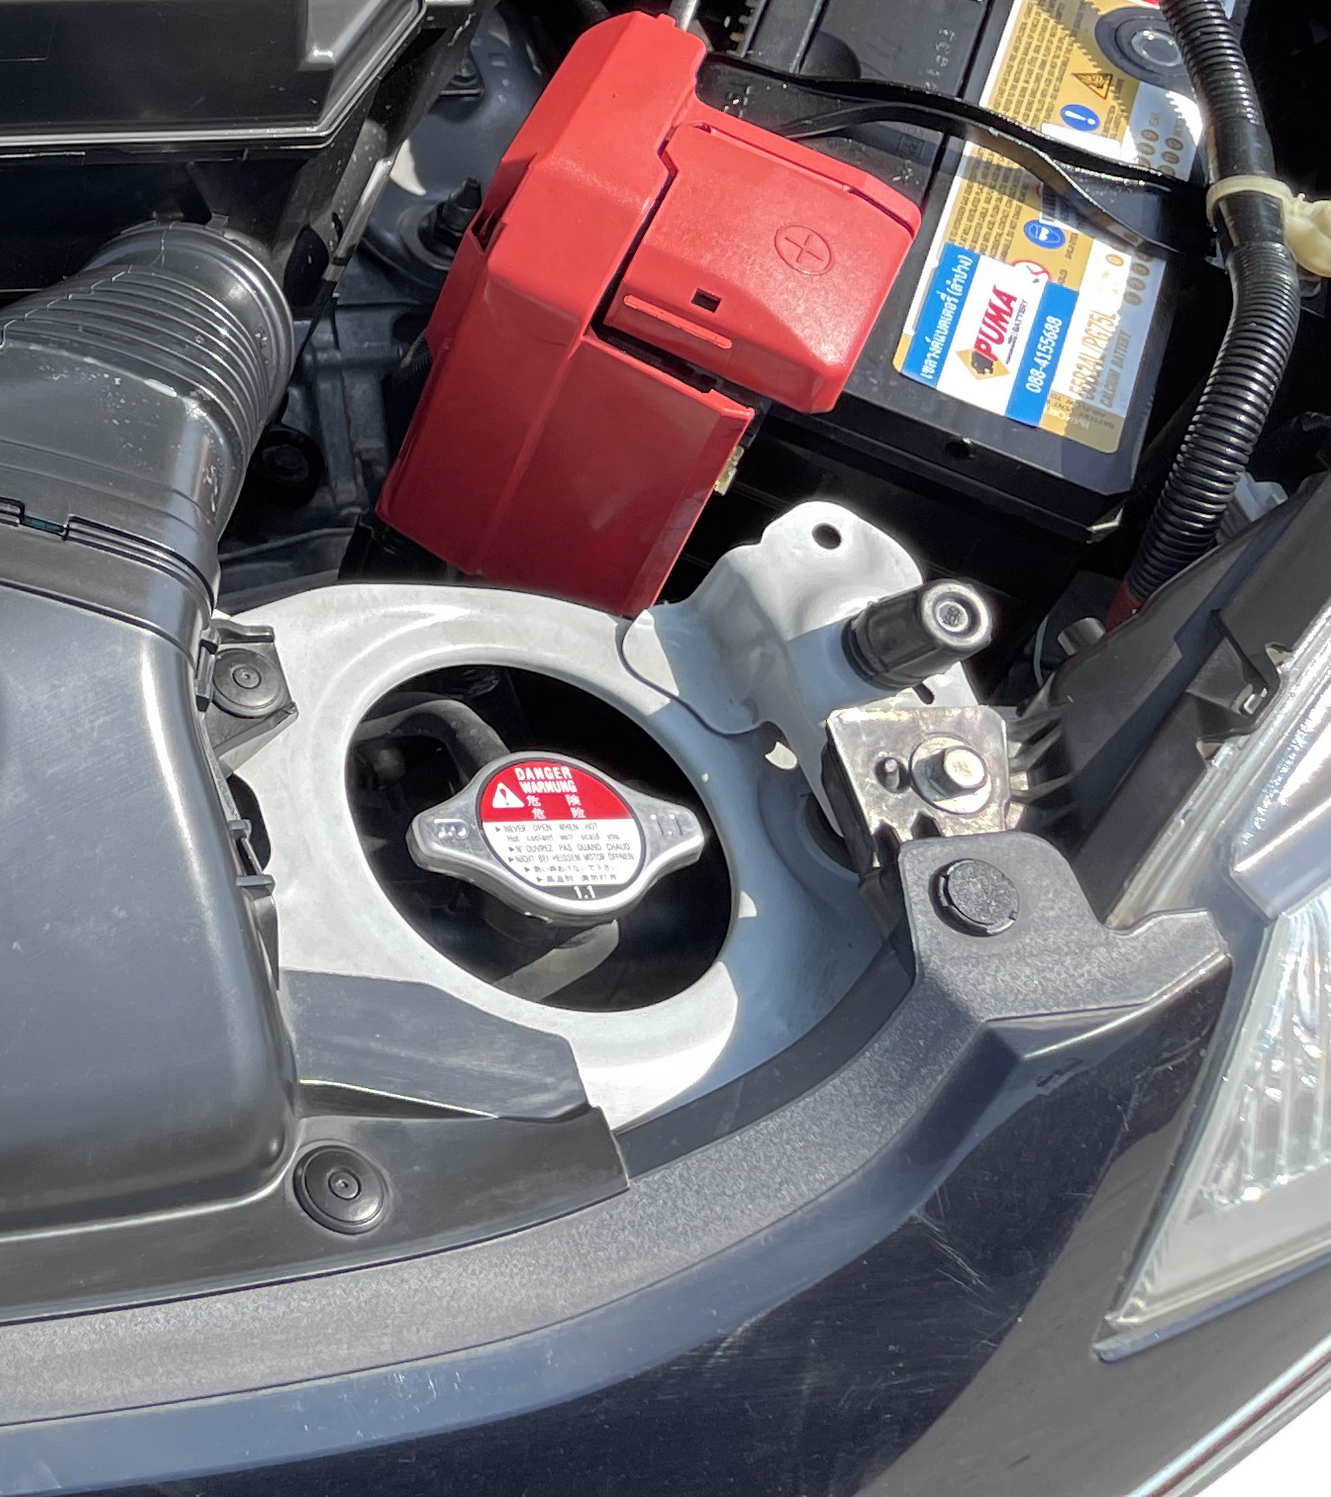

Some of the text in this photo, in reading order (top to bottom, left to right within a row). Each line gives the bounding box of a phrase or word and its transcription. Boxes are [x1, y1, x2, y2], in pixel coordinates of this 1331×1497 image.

[945, 255, 974, 297] (ลำปาง)
[974, 284, 1018, 362] PUMA
[1013, 299, 1028, 334] BATTERY
[1025, 315, 1063, 394] 088-4155688
[1100, 329, 1132, 408] CALCIUM BATTERY
[515, 766, 573, 781] DANGER
[519, 780, 577, 794] WARNUNG
[533, 824, 552, 832] OPEN
[559, 823, 579, 831] WHEN
[577, 843, 602, 851] QUAND
[606, 843, 631, 851] CHAUD
[583, 853, 605, 861] MOTOR
[574, 885, 596, 899] 1.1
